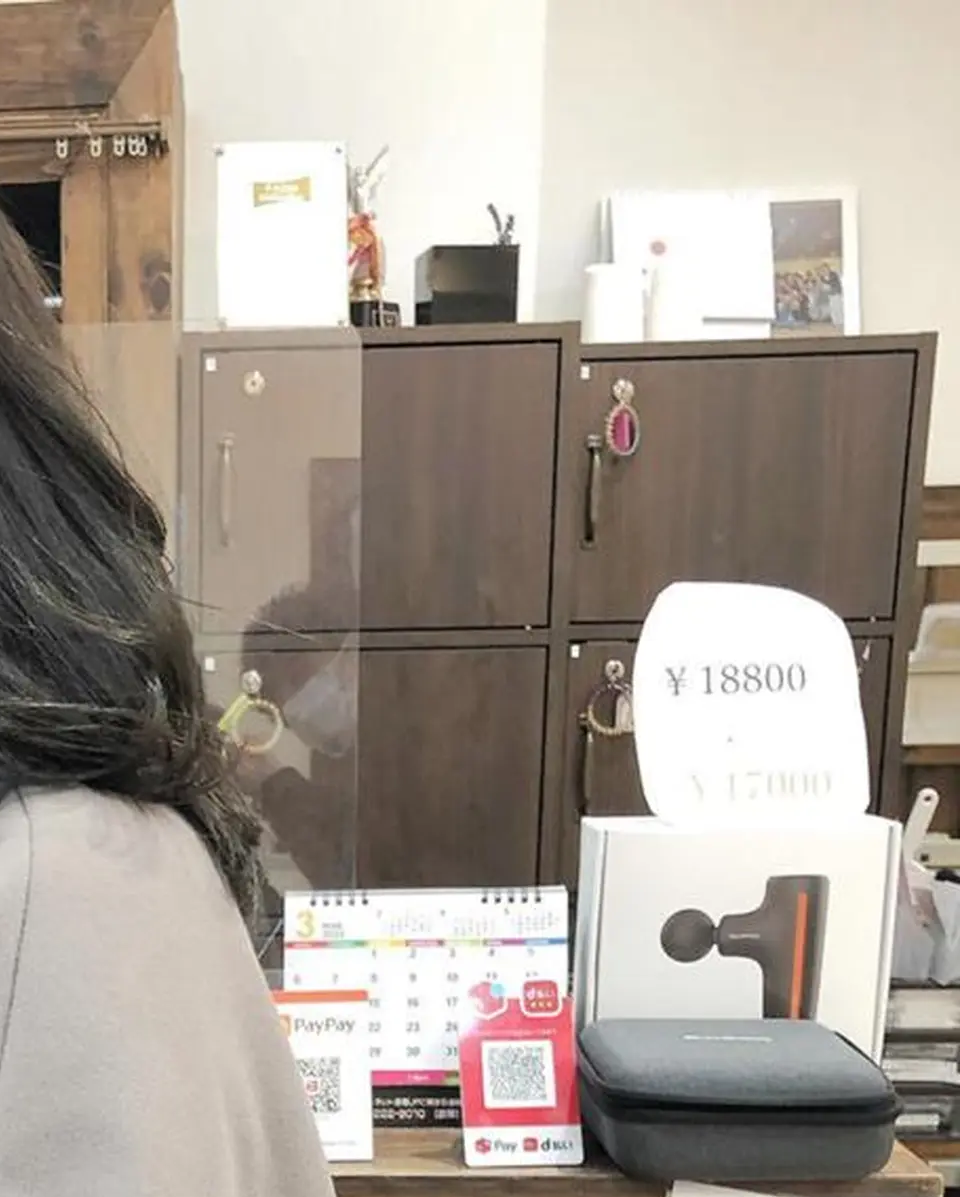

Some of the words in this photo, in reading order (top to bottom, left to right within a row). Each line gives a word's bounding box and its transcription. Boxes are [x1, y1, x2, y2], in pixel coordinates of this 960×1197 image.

[295, 909, 315, 938] 3
[446, 996, 460, 1008] 17
[294, 1016, 356, 1036] PayPay
[367, 1021, 382, 1033] 22
[405, 1021, 420, 1033] 23
[405, 1045, 421, 1058] 30
[493, 1137, 518, 1154] Pay
